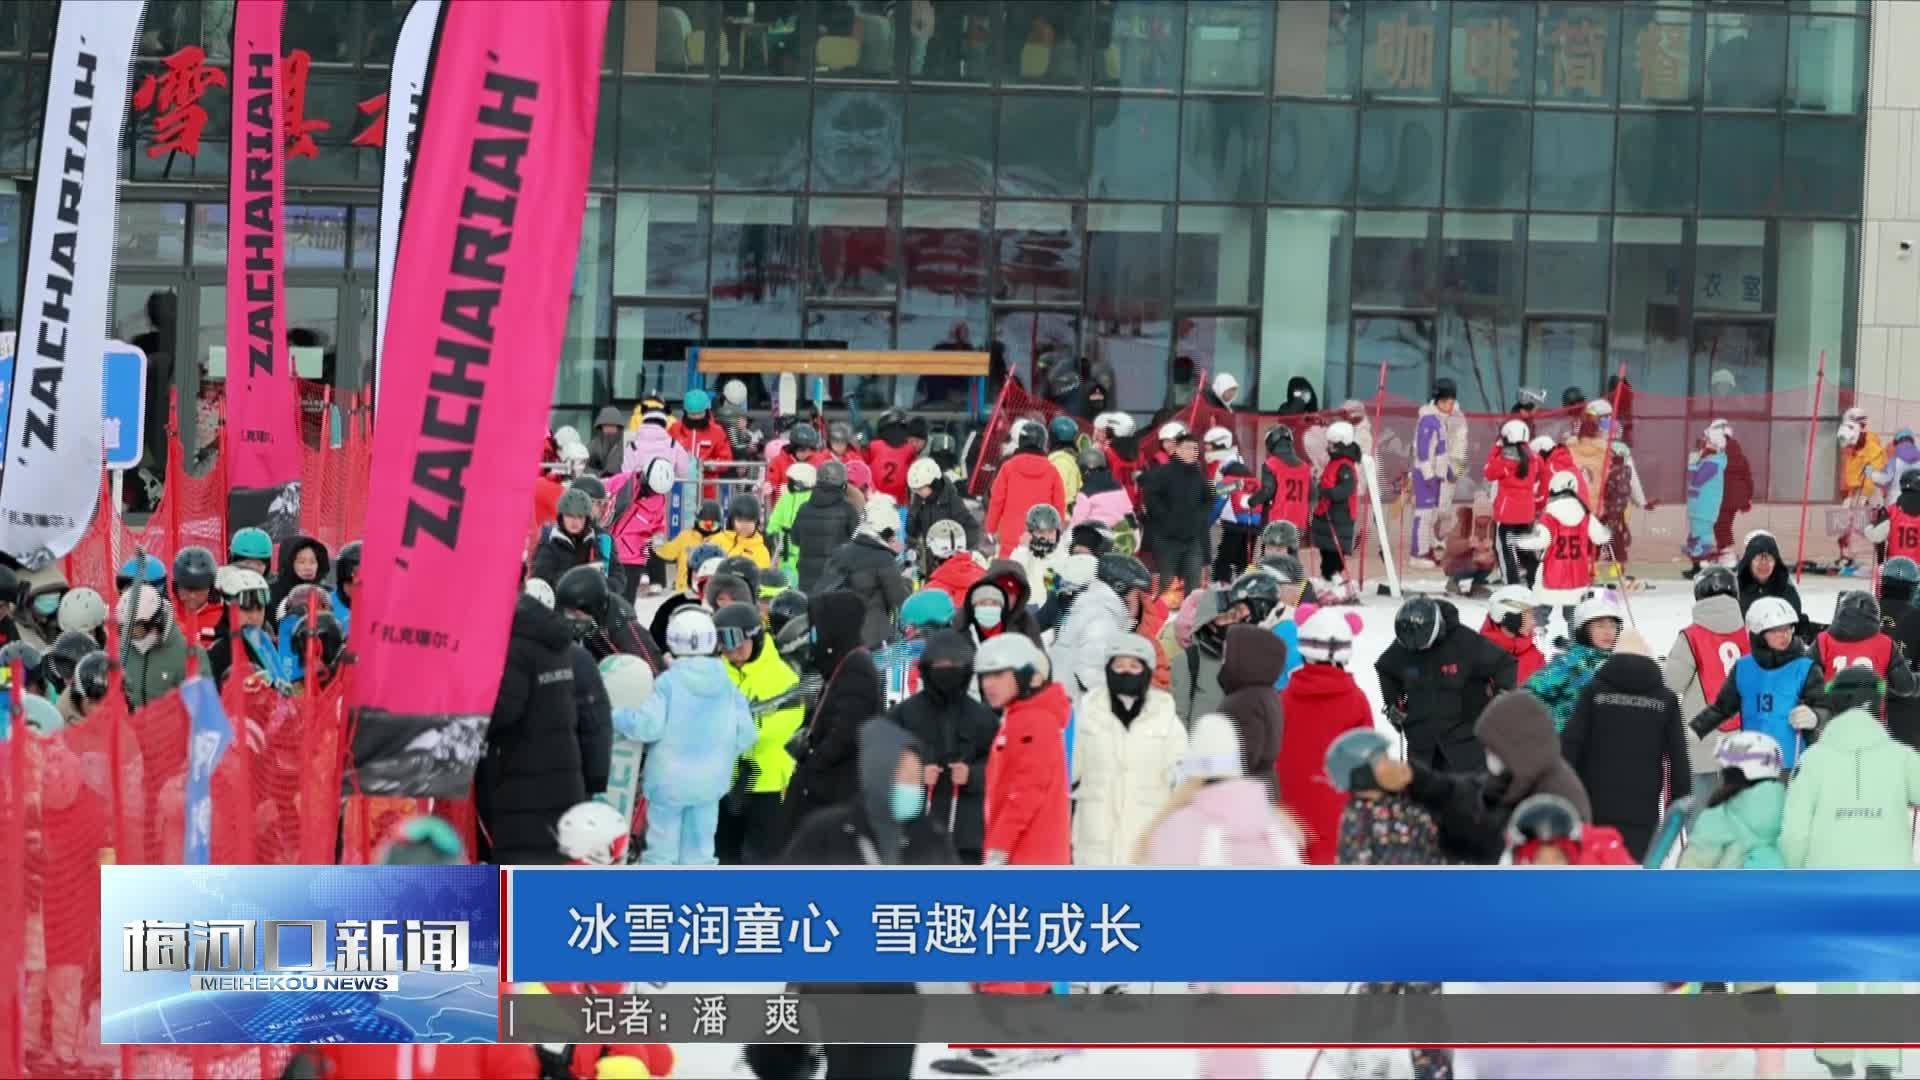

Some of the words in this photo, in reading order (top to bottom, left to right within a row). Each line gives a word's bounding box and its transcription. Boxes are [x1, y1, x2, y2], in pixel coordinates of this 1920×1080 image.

[882, 461, 898, 484] 2
[1285, 479, 1304, 502] 21
[1556, 535, 1581, 560] 25
[1898, 526, 1919, 549] 16
[1756, 693, 1774, 713] 13
